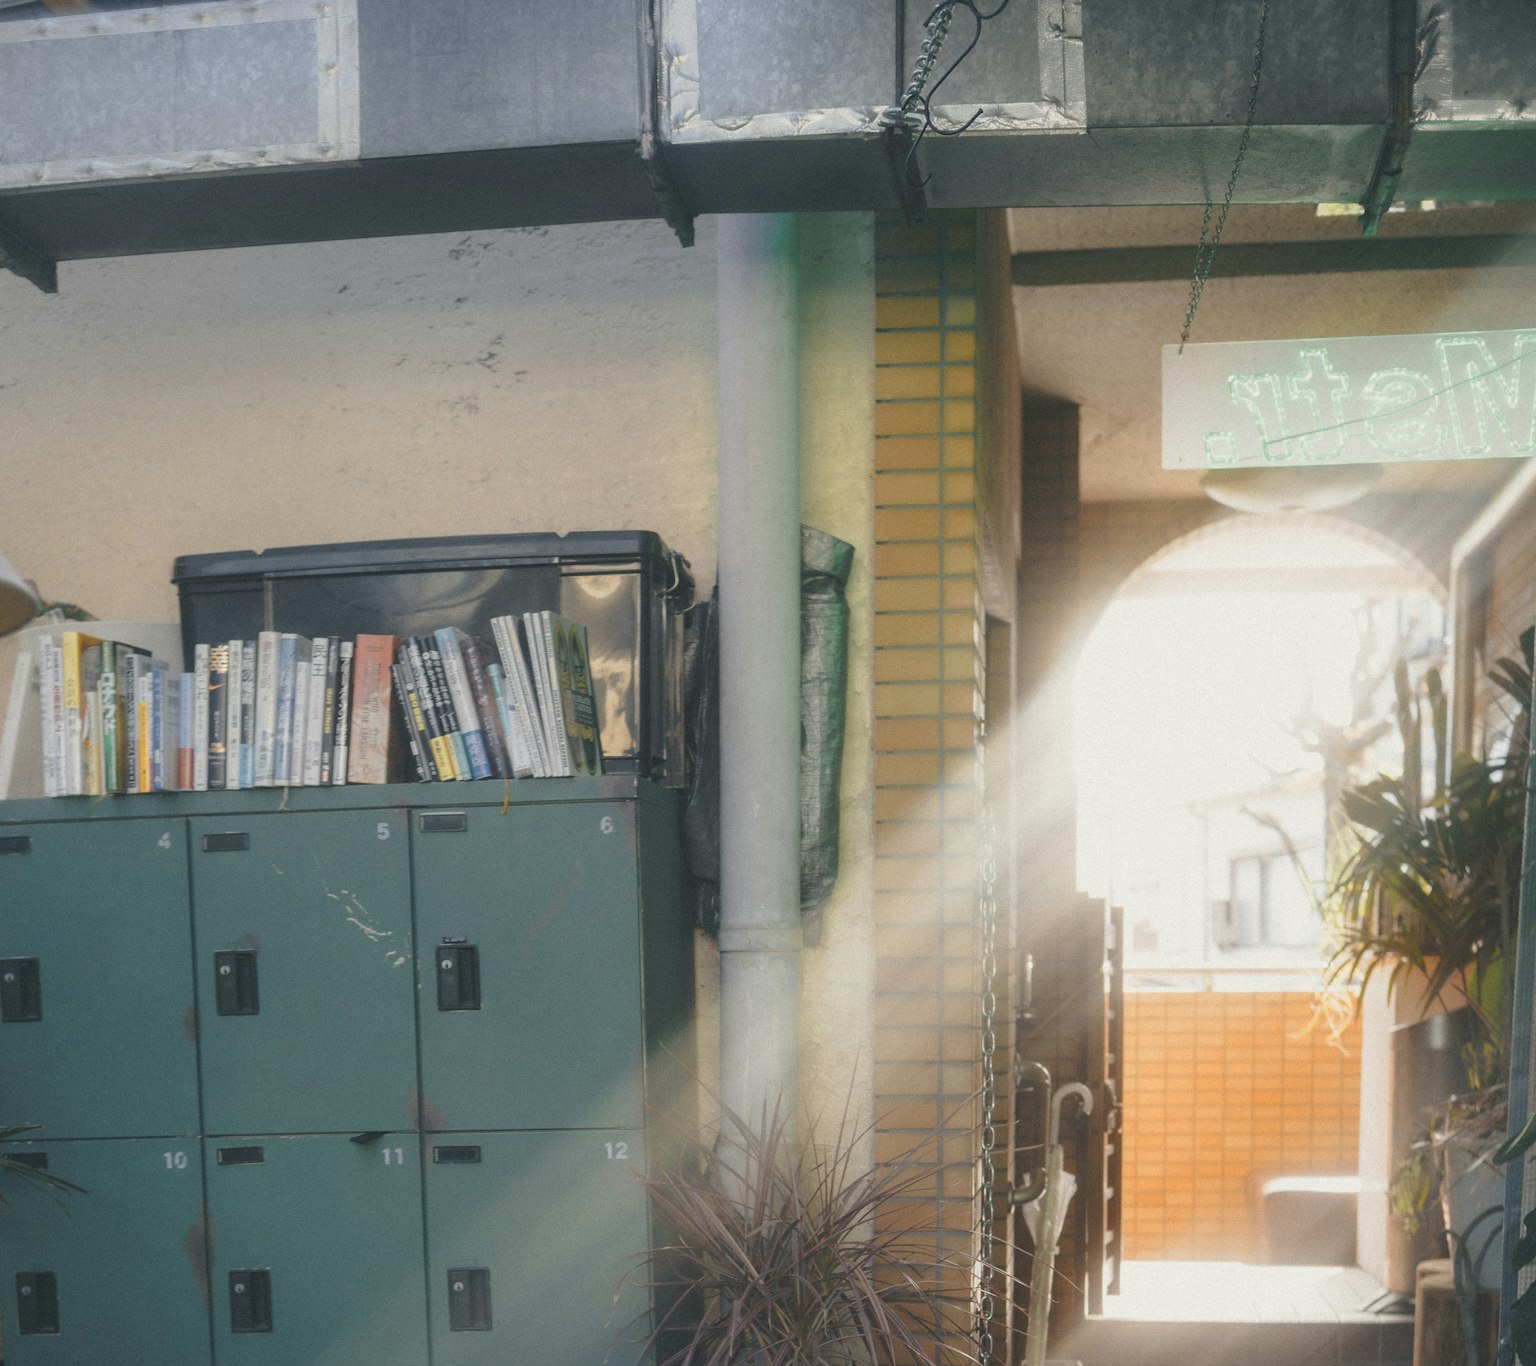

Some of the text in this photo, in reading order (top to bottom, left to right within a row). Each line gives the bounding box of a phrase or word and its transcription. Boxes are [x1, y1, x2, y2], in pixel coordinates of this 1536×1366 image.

[377, 822, 390, 840] 5
[600, 816, 613, 834] 6
[158, 832, 171, 849] 4
[164, 1151, 187, 1169] 10
[382, 1148, 404, 1165] 11
[605, 1142, 628, 1160] 12
